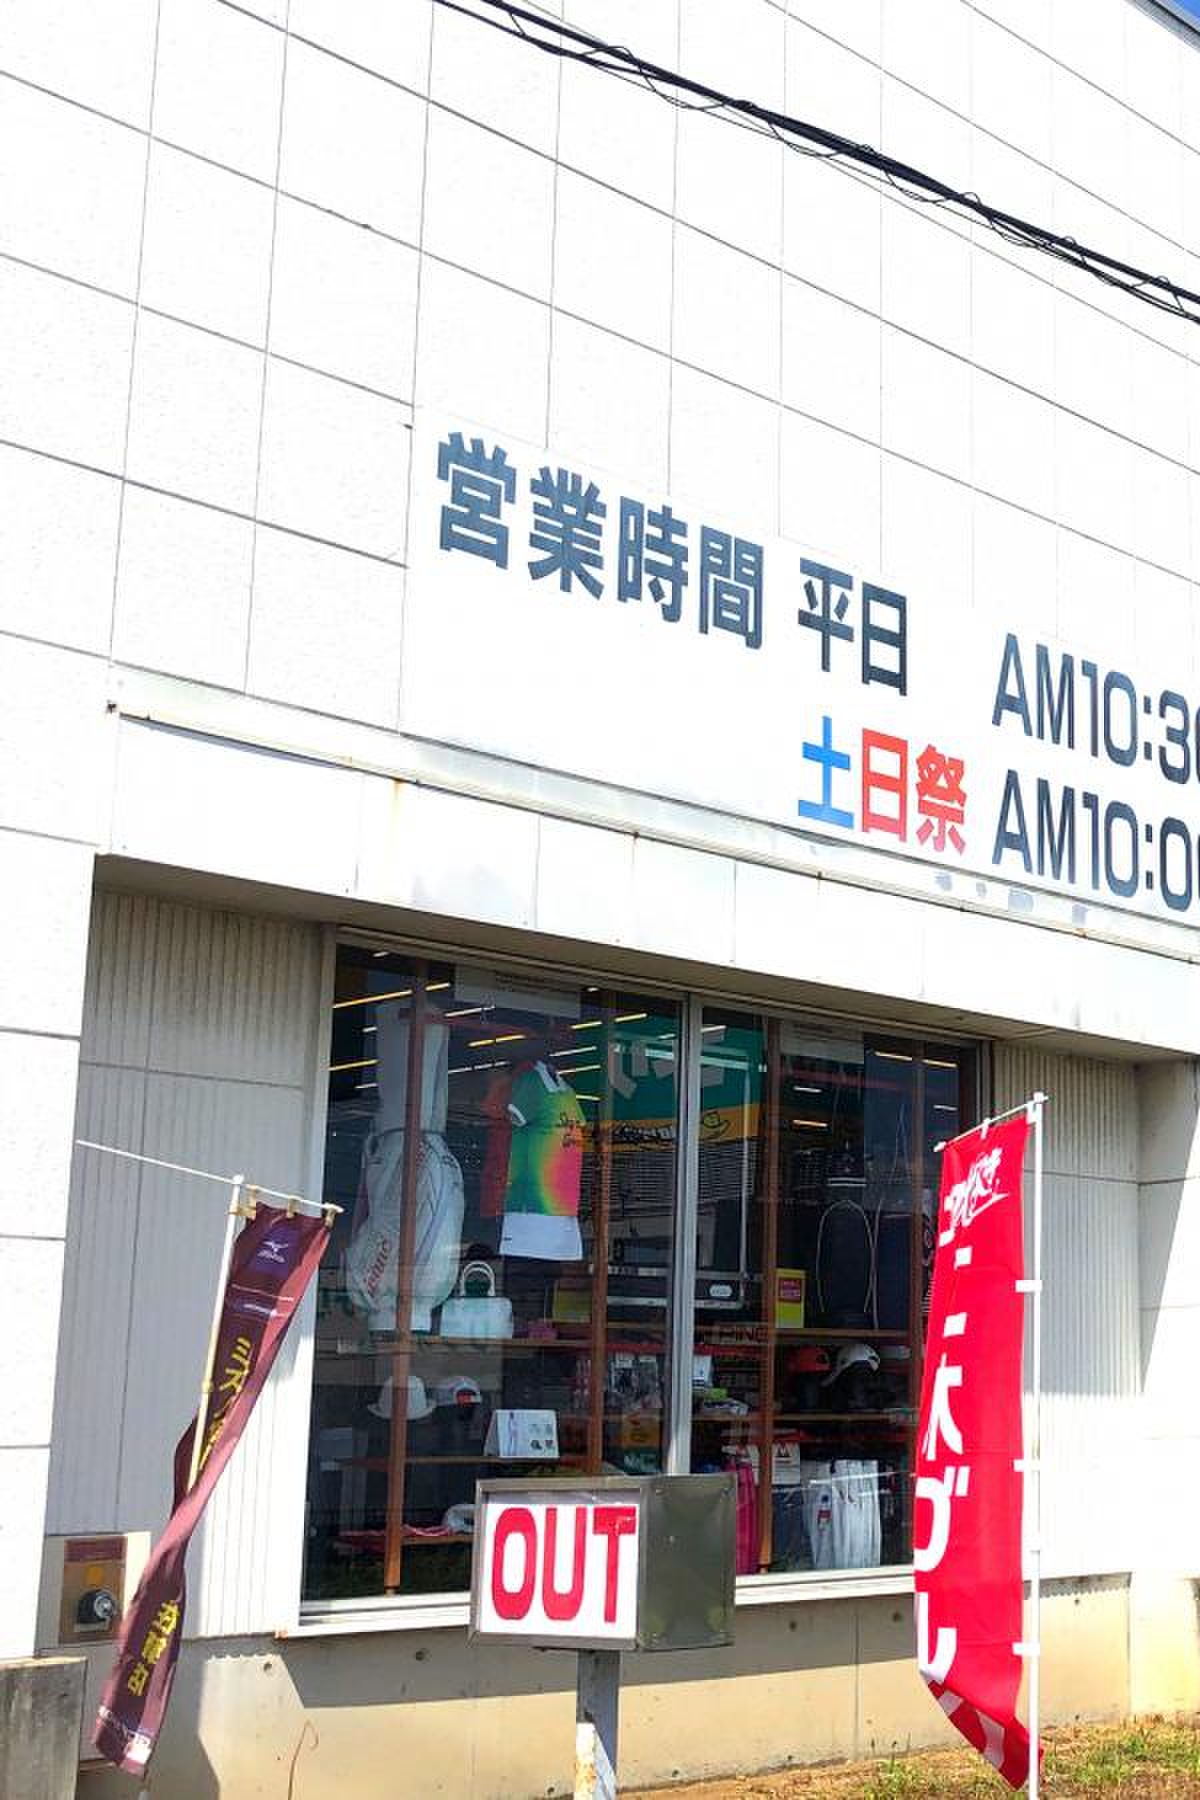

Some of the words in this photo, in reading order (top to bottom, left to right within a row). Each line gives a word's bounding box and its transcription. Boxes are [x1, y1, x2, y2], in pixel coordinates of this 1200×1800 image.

[437, 432, 763, 650] 営業時間
[797, 558, 908, 697] 平日
[798, 715, 967, 854] 土日祭
[491, 1506, 637, 1624] OUT
